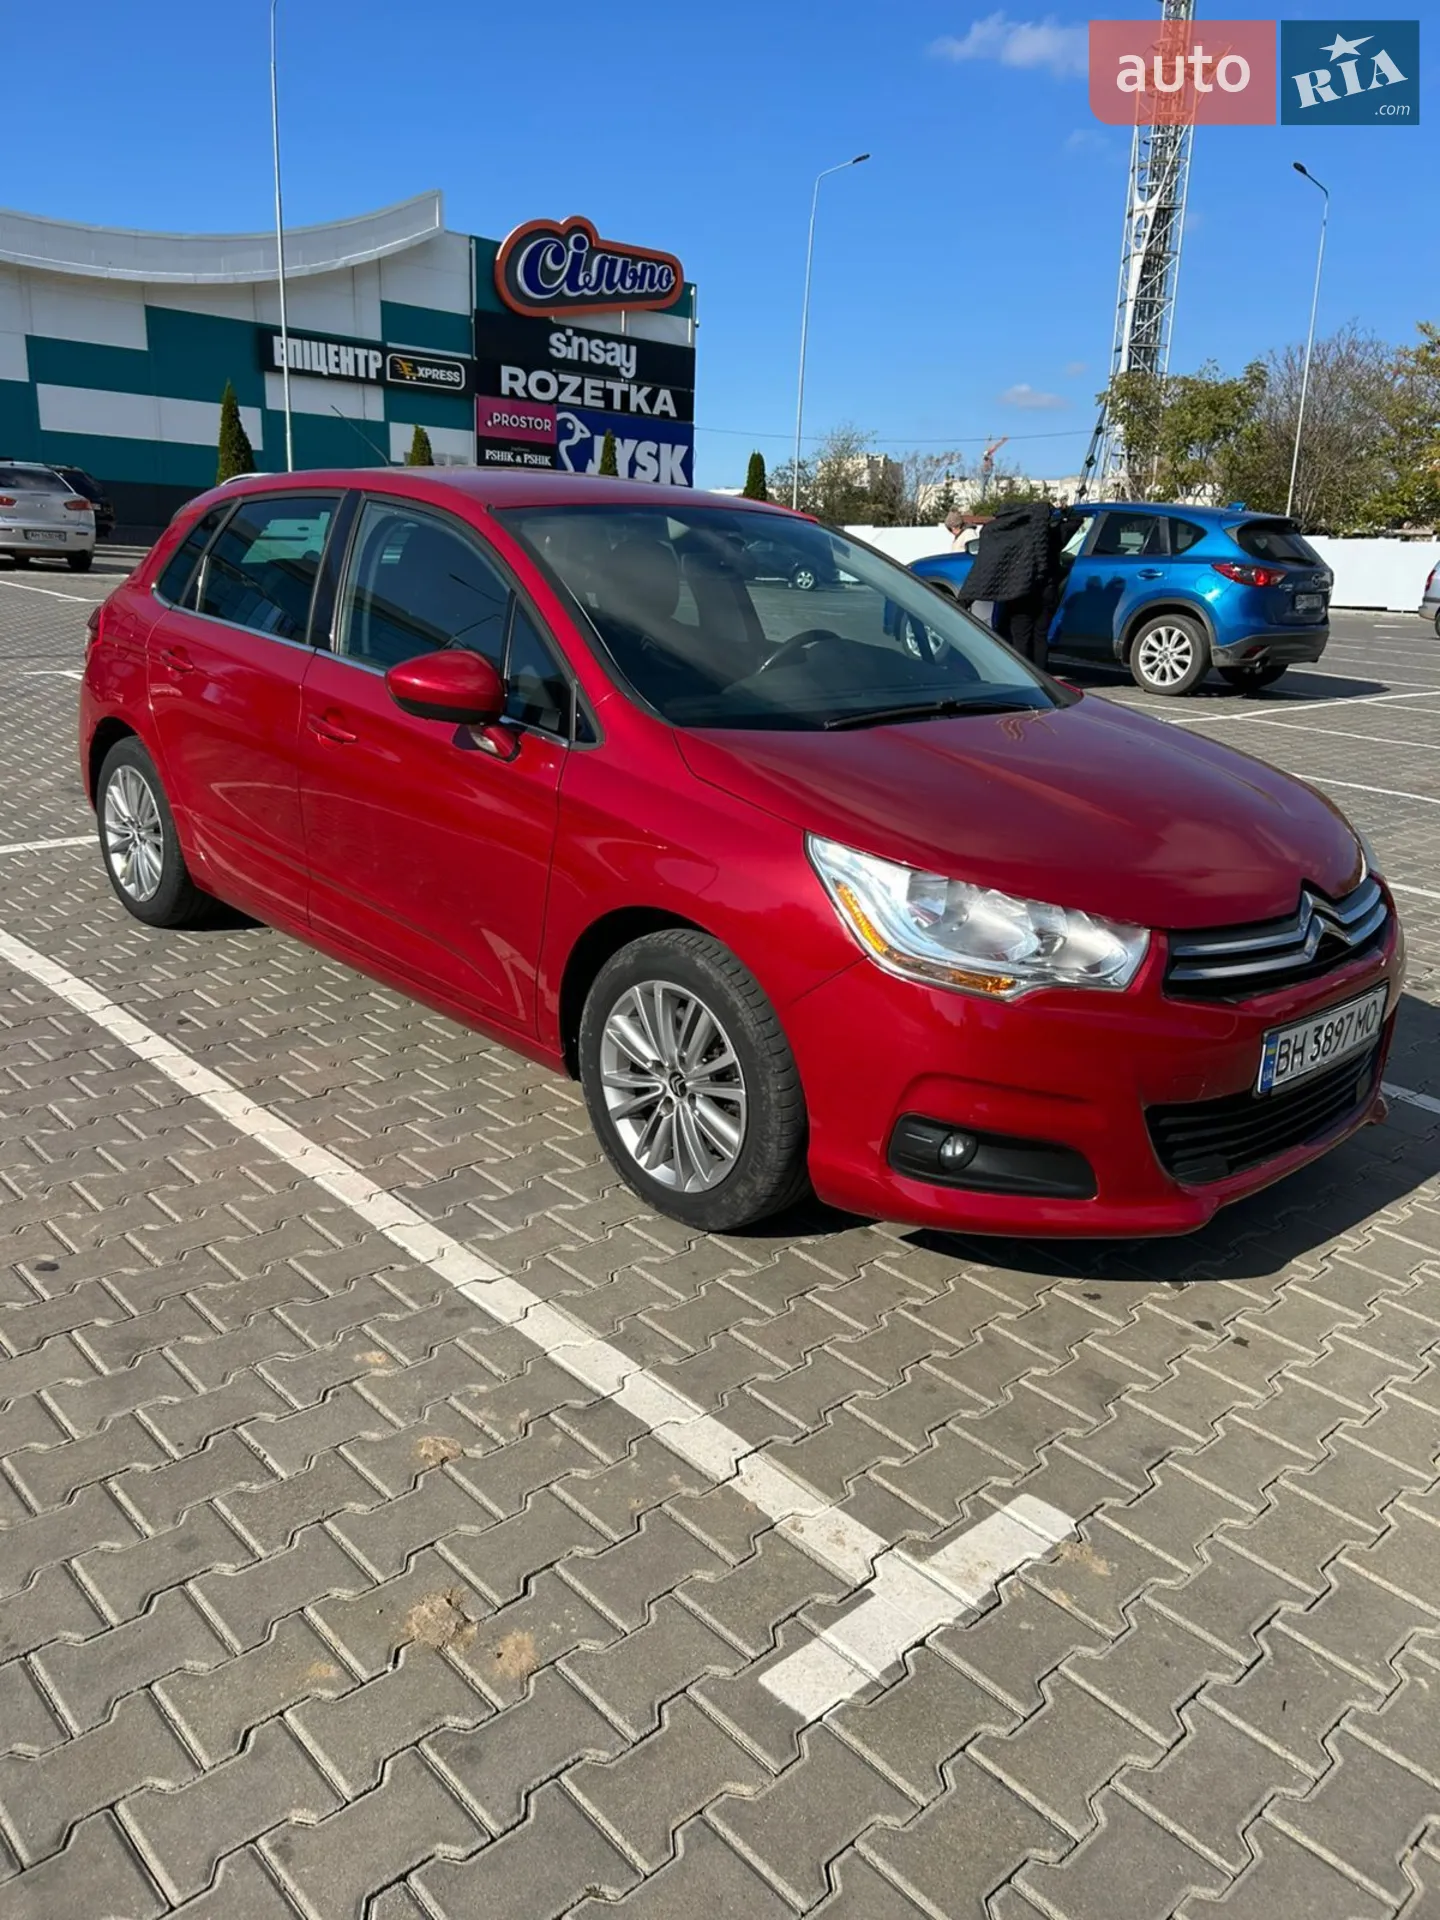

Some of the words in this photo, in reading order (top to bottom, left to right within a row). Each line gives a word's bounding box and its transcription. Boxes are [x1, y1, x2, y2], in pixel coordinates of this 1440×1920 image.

[517, 233, 675, 299] Сільпо
[549, 329, 636, 378] sinsay
[501, 366, 677, 417] ROZETKA
[485, 450, 513, 462] PSHIK
[523, 454, 551, 466] PSHIK
[1310, 1012, 1354, 1062] 3897
